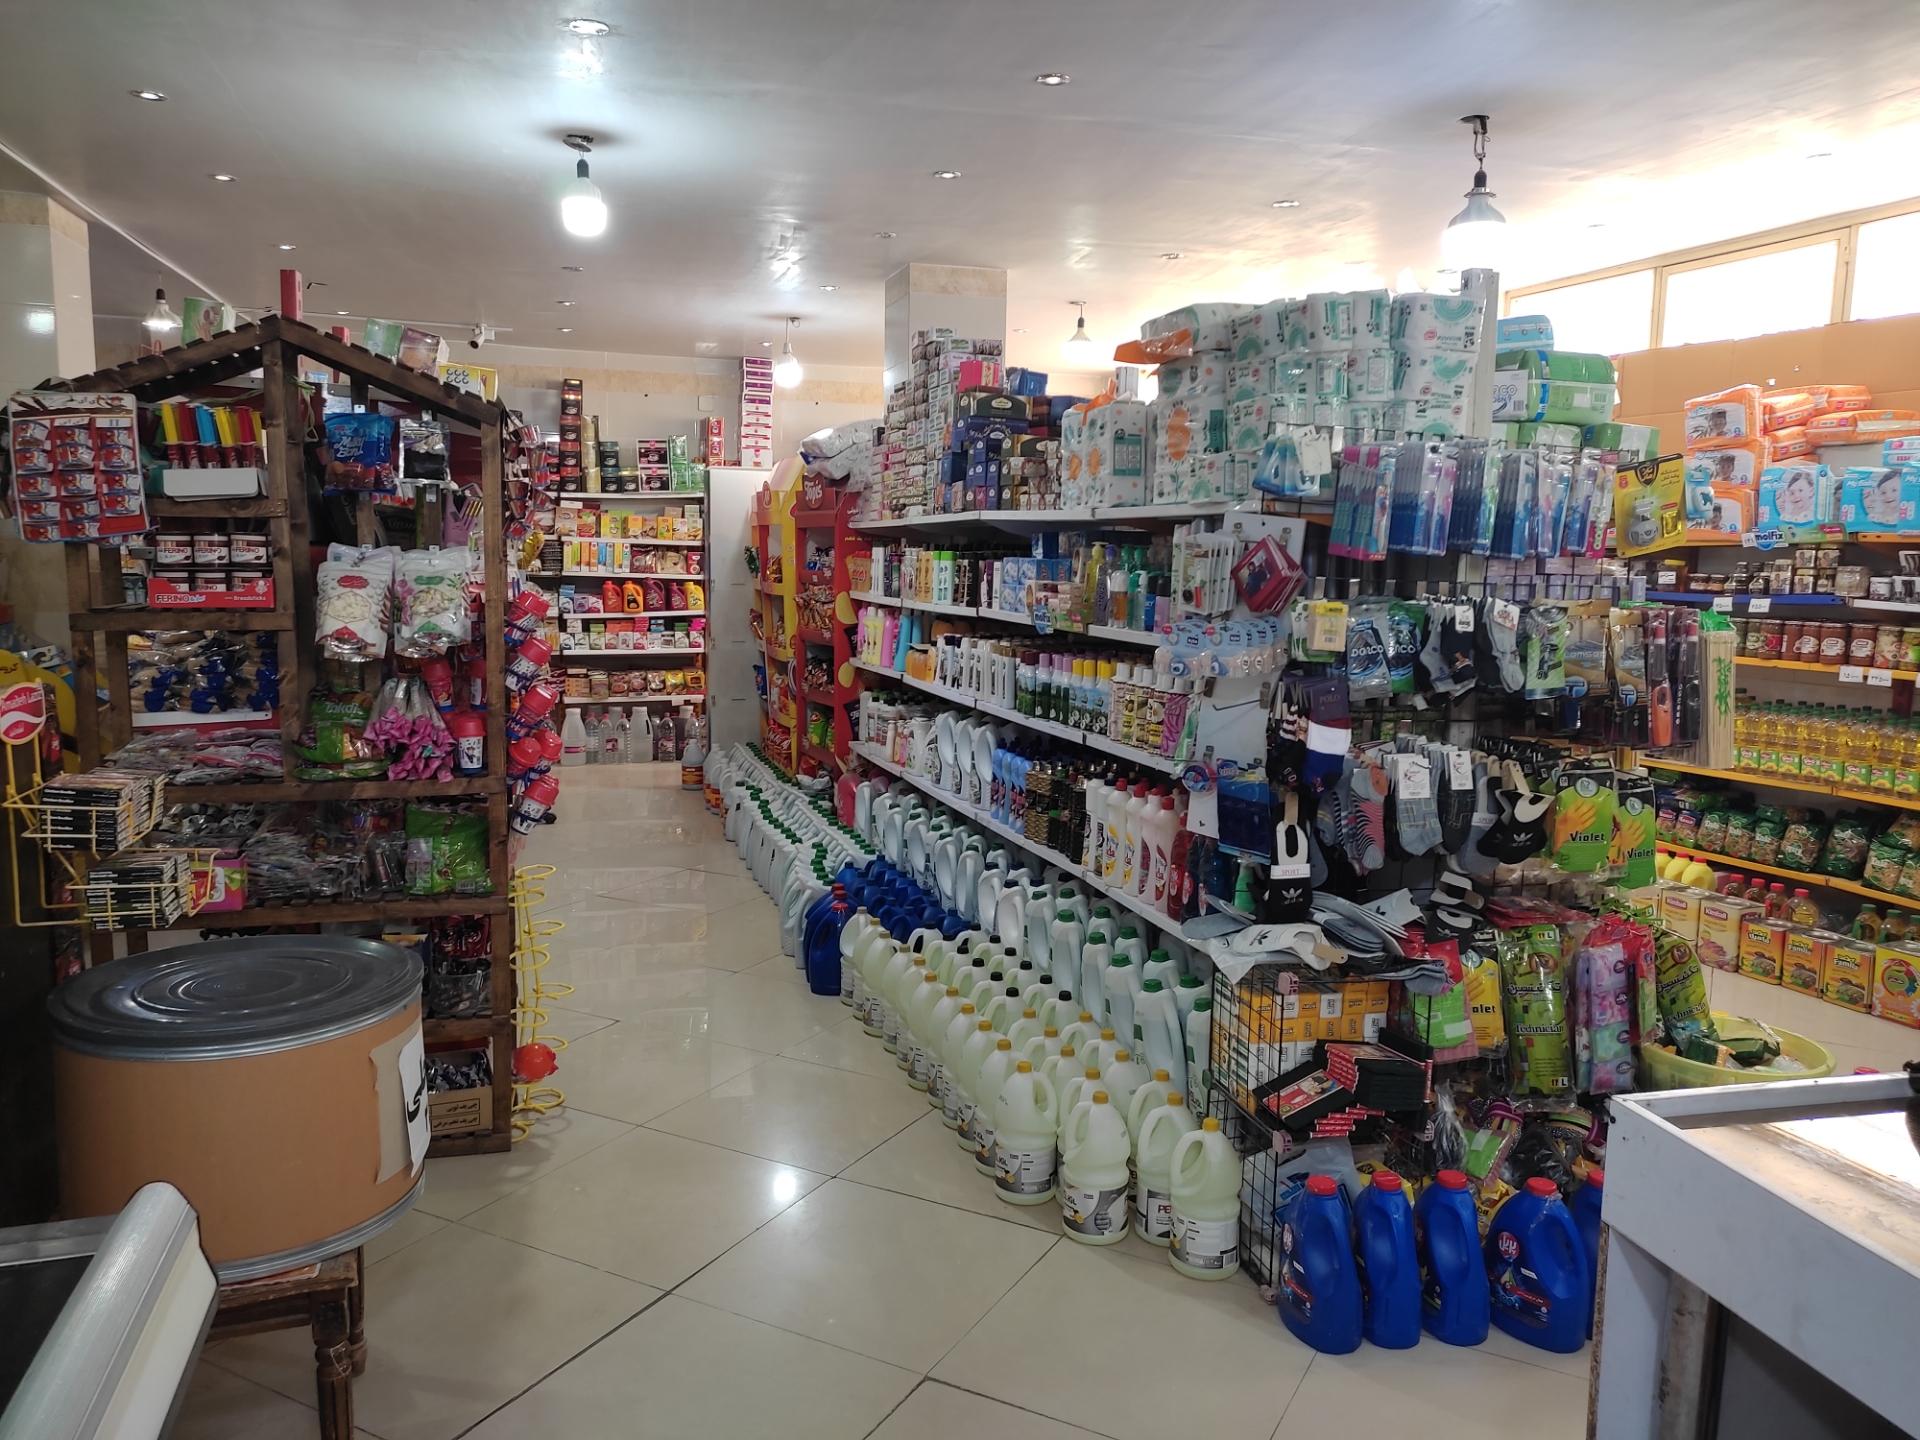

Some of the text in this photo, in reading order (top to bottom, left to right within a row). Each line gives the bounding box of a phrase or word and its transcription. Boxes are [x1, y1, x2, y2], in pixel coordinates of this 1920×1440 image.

[156, 593, 189, 604] FERINO
[1351, 645, 1384, 657] DORCO
[1570, 830, 1605, 842] Violet
[1627, 847, 1654, 859] Violet
[1472, 1003, 1496, 1014] olet
